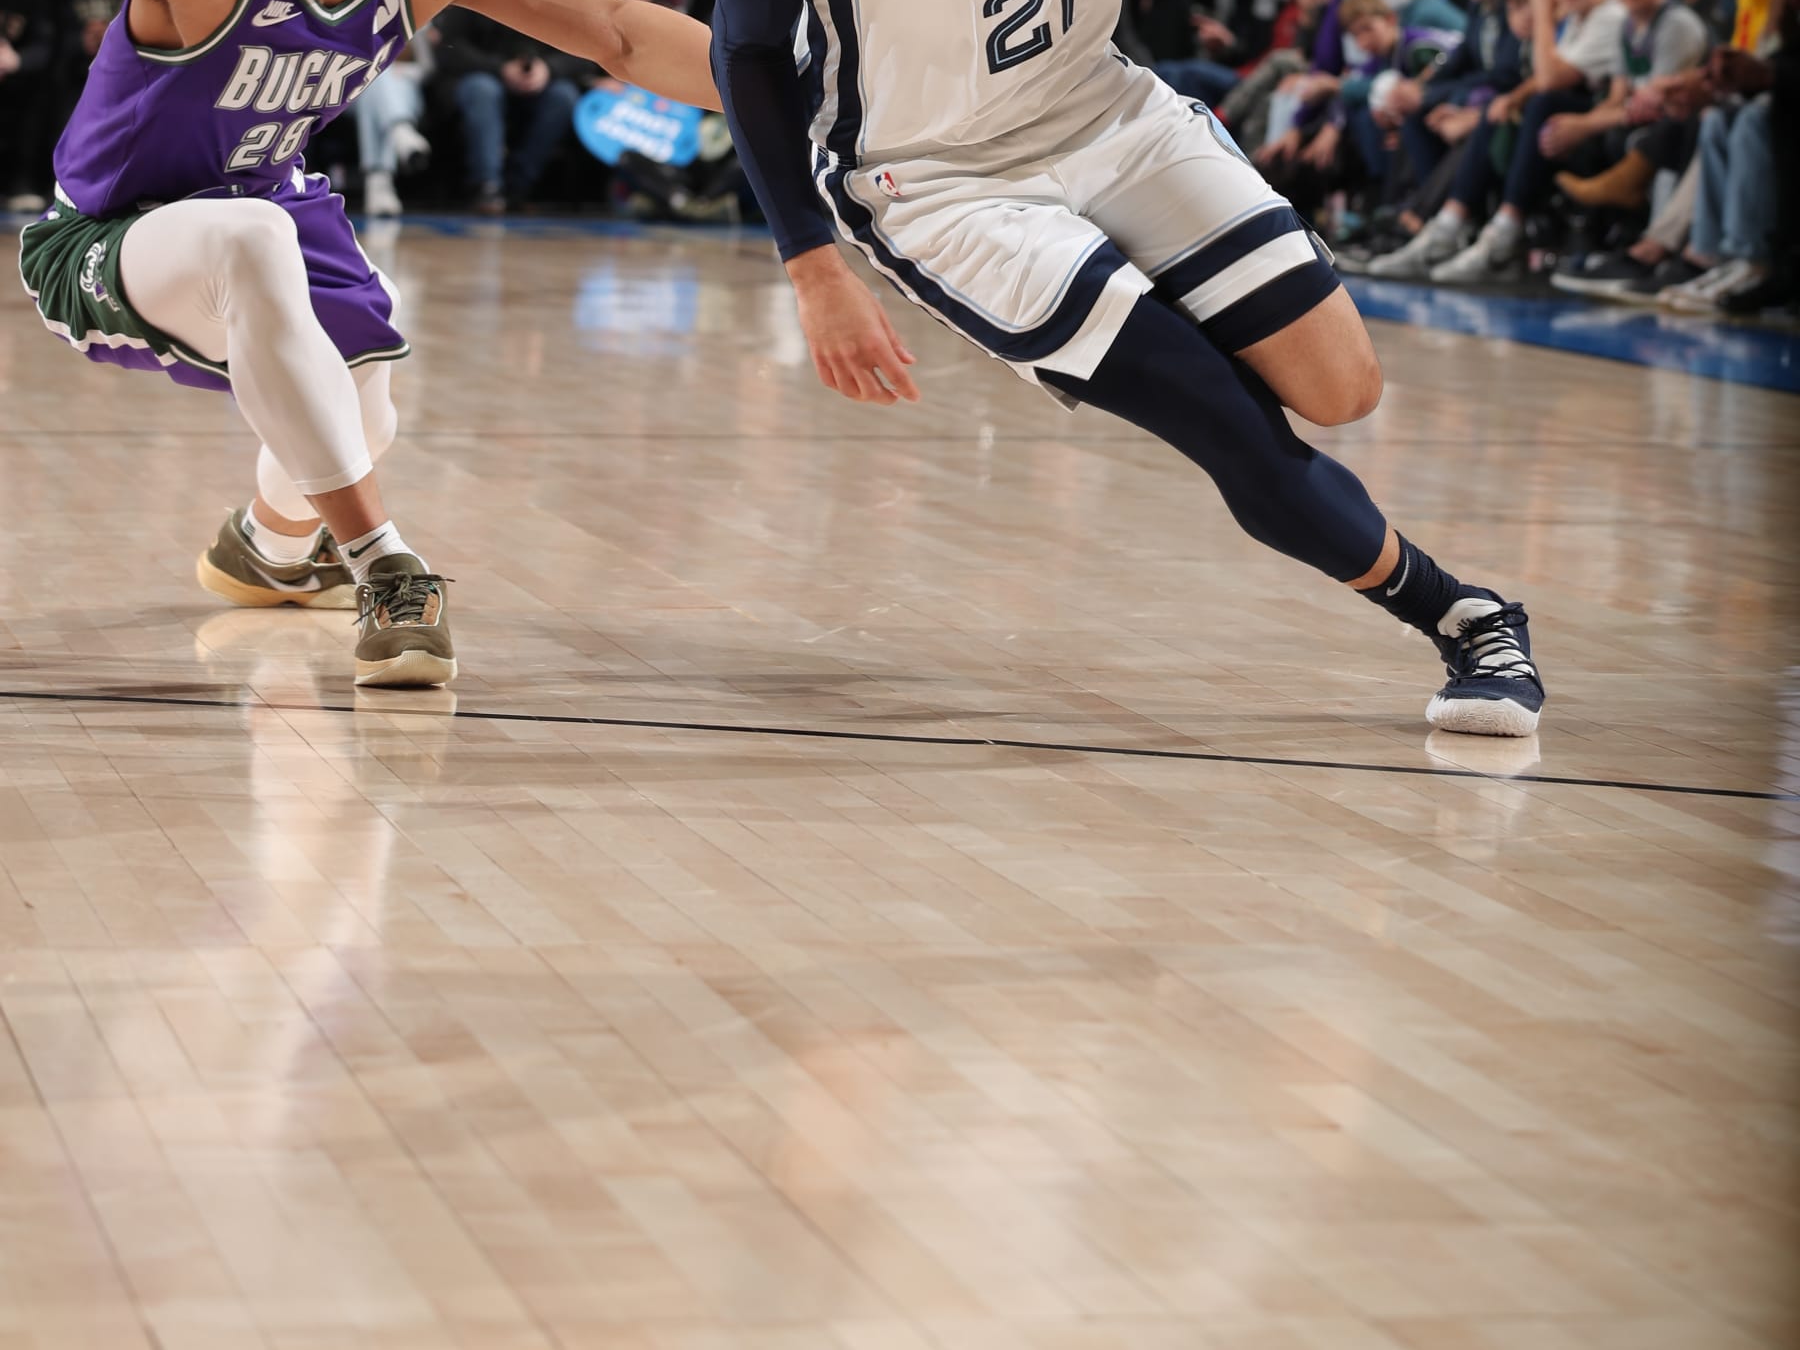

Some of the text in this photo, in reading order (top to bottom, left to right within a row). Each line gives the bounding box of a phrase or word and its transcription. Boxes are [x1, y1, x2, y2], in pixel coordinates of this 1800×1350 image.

[262, 0, 295, 19] NIKE
[214, 35, 399, 114] BUCKS
[224, 116, 320, 173] 28
